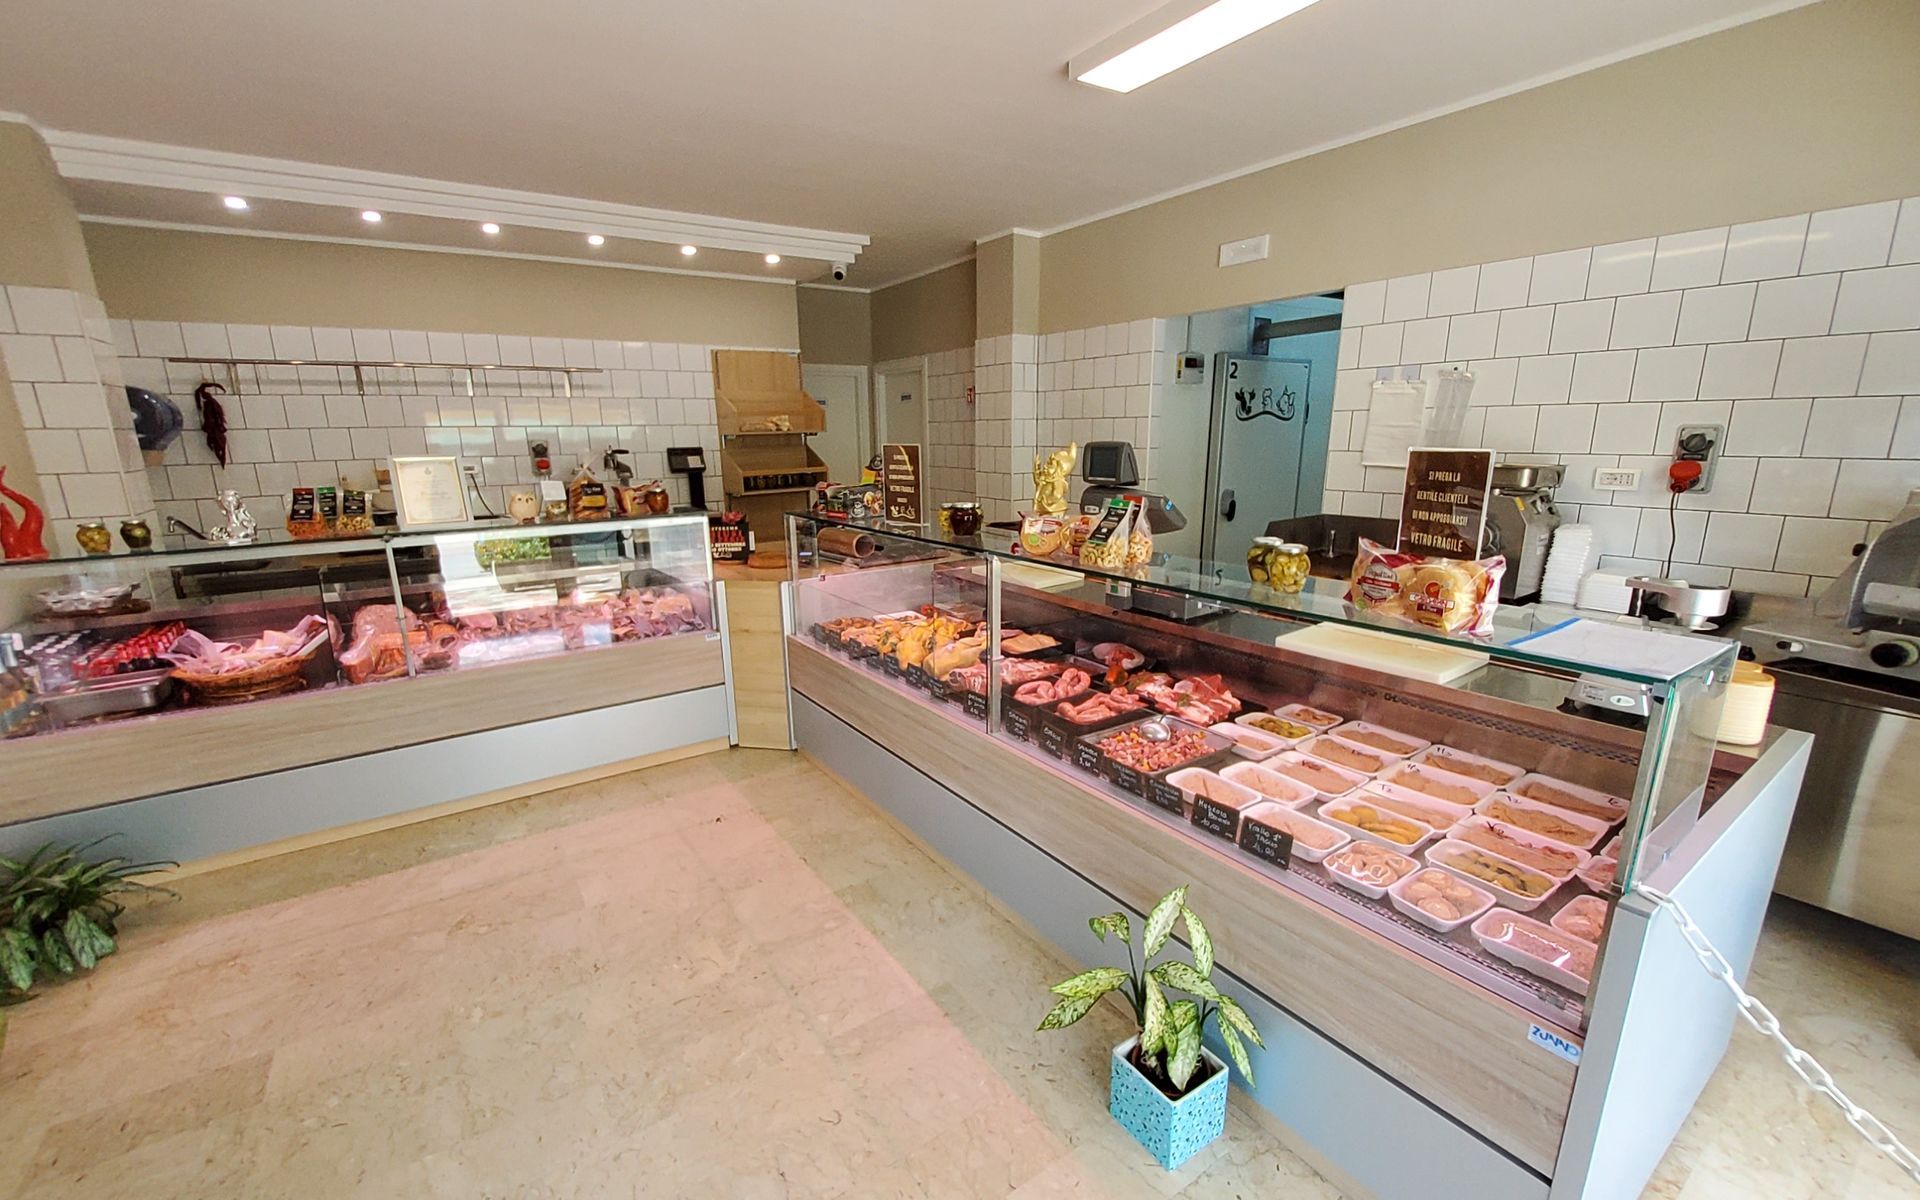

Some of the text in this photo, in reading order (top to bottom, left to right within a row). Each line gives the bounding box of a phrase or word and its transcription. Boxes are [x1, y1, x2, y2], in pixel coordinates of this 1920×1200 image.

[1229, 362, 1238, 379] 2
[1428, 471, 1461, 482] SI PREGA LA
[1416, 490, 1469, 505] GENTILE CLIENTELA
[1419, 510, 1429, 521] NON
[1410, 531, 1463, 553] VETRO FRAGILE
[1532, 1025, 1579, 1057] ZUNNO
